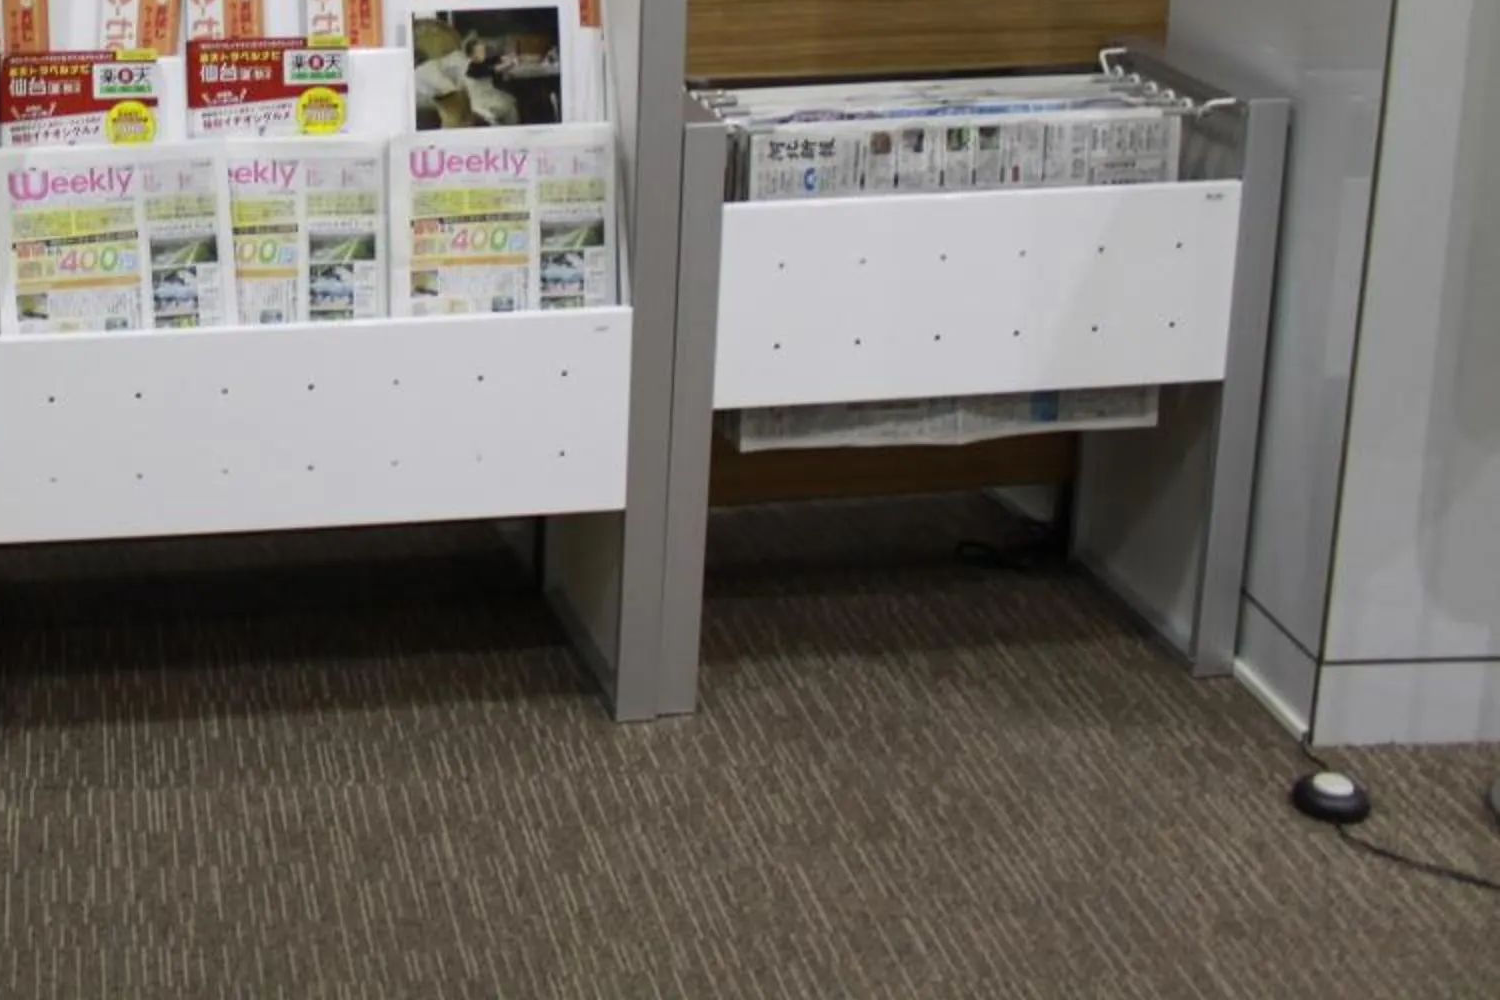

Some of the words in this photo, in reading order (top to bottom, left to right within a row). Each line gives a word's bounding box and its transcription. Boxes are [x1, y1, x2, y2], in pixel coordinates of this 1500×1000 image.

[228, 158, 298, 188] ekly
[409, 146, 528, 179] Weekly
[8, 165, 134, 201] Weekly
